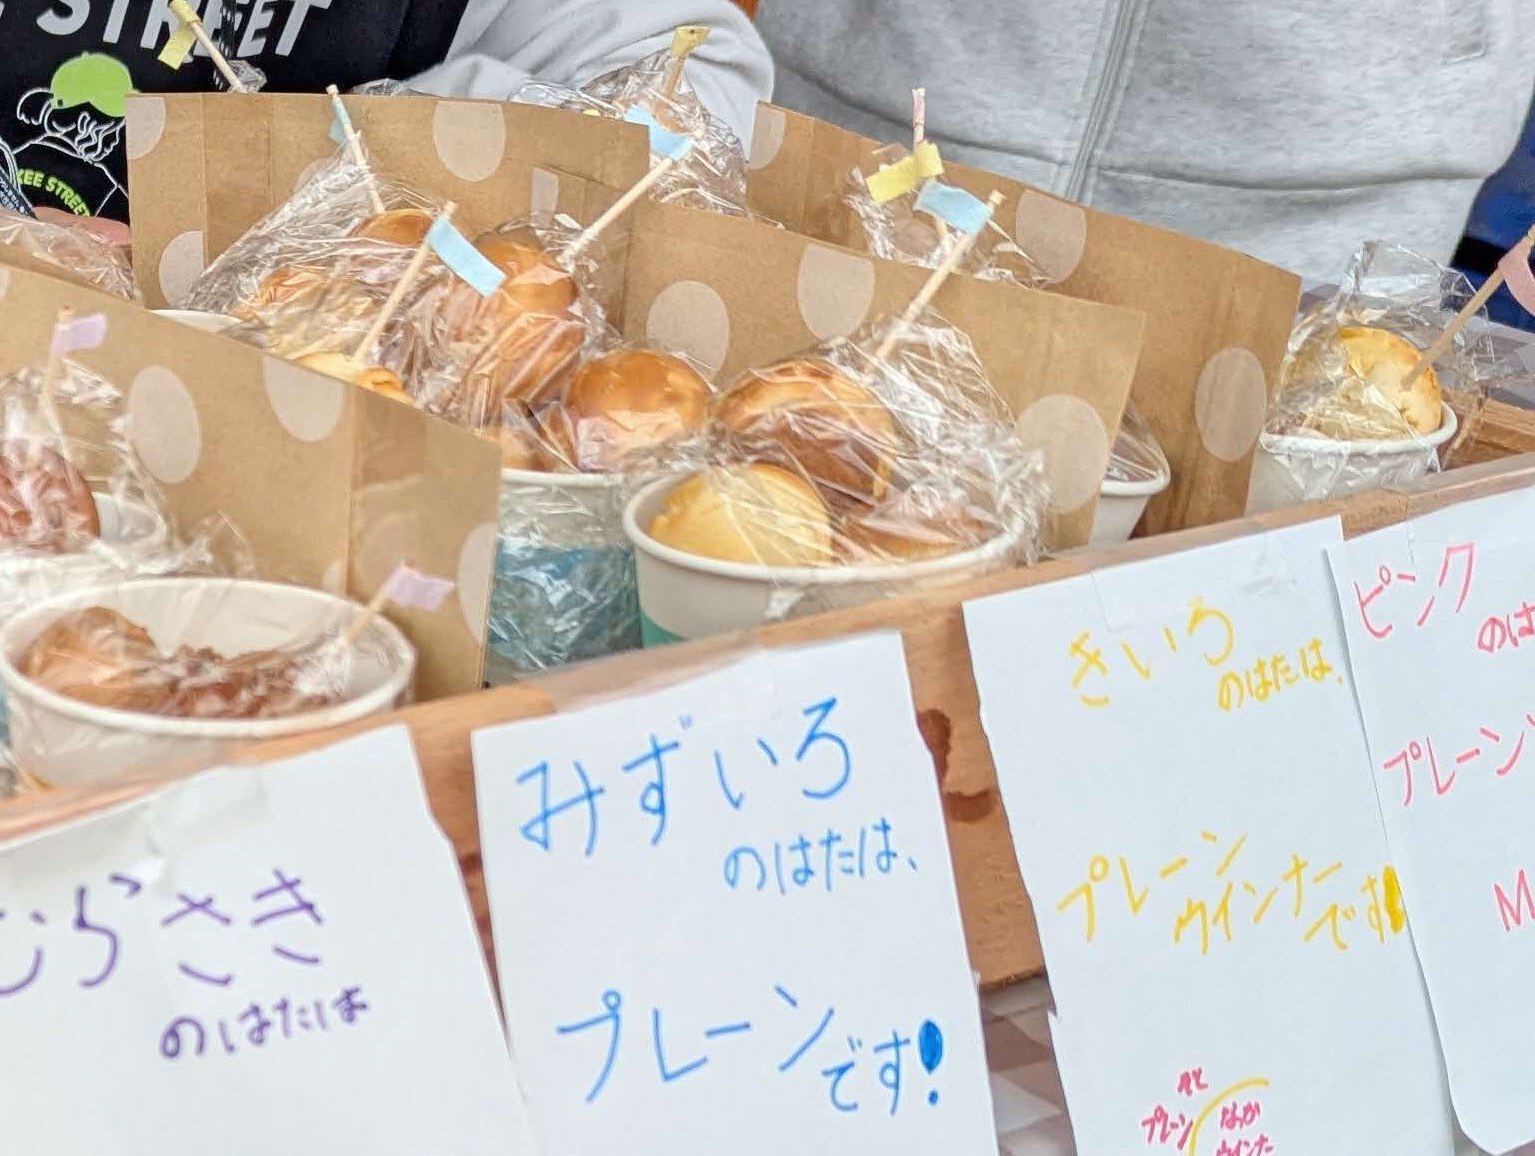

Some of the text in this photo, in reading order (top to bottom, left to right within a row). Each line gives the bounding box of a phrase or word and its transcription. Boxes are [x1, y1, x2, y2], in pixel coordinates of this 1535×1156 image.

[1353, 541, 1475, 639] ピンク
[1068, 595, 1236, 708] きいろ
[516, 697, 852, 857] みずいろ
[1056, 831, 1248, 944] プレーン
[159, 985, 369, 1060] のはたは
[556, 985, 944, 1116] プレーンです!
